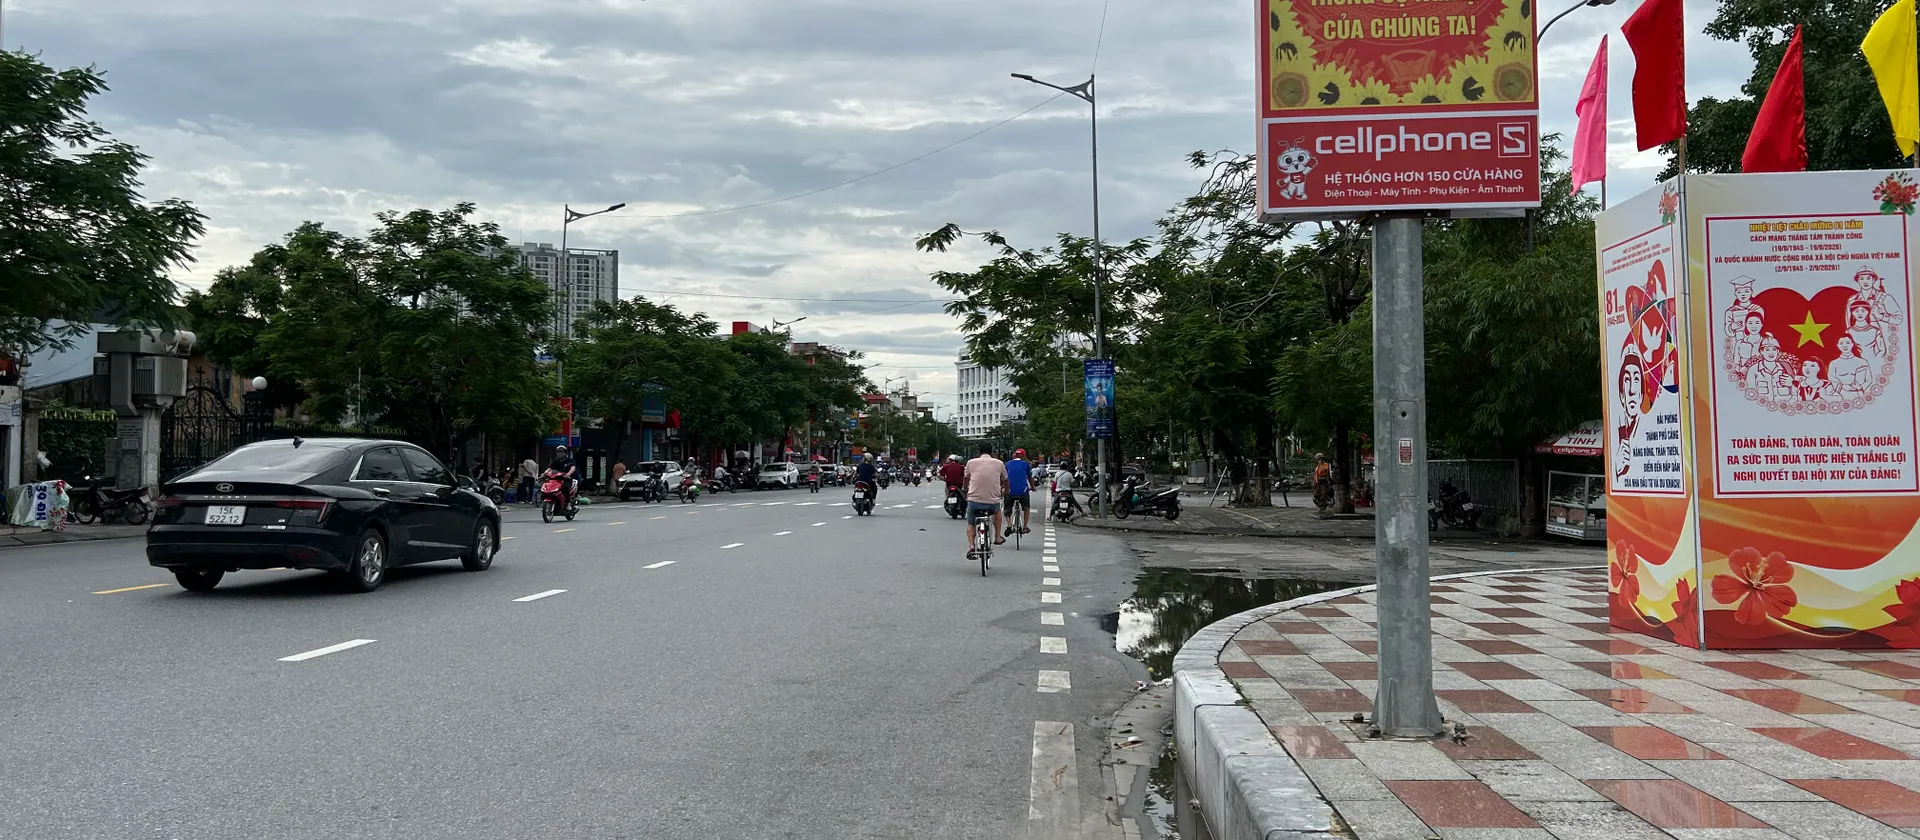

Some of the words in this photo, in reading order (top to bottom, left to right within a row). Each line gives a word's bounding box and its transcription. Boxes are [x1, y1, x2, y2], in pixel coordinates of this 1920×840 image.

[1324, 13, 1364, 40] CỦA
[1370, 13, 1440, 38] CHÚNG
[1447, 15, 1476, 36] TA!
[1325, 172, 1342, 186] HỆ
[1345, 169, 1391, 183] THỐNG
[1394, 171, 1424, 182] HƠN
[1427, 170, 1450, 181] 150
[1453, 168, 1482, 180] CỬA
[1484, 168, 1523, 180] HÀNG
[1324, 189, 1345, 198] Điện
[1347, 188, 1372, 197] Thoại
[1380, 188, 1399, 197] Máy
[1401, 186, 1421, 195] Tính
[1429, 186, 1447, 196] Phụ
[1449, 186, 1469, 196] Kiện
[1478, 184, 1494, 194] Âm
[1495, 185, 1524, 193] Thanh
[1749, 222, 1771, 233] NHIỆT
[1772, 222, 1788, 232] LIỆT
[1789, 221, 1809, 231] CHÀO
[1810, 220, 1833, 230] MỪNG
[1845, 219, 1863, 229] NĂM
[1724, 254, 1740, 263] QUỐC
[1825, 253, 1835, 262] HỘI
[1871, 252, 1884, 260] VIỆT
[1606, 288, 1617, 315] 81
[1731, 437, 1756, 448] TOÀN
[1759, 435, 1789, 448] ĐẢNG,
[1791, 436, 1817, 447] TOÀN
[1820, 435, 1842, 448] DÂN,
[1845, 435, 1870, 446] TOÀN
[1874, 434, 1900, 447] QUÂN
[1727, 456, 1739, 465] RA
[1742, 453, 1761, 464] SỨC
[1764, 454, 1779, 464] THI
[1782, 454, 1801, 464] ĐUA
[1804, 453, 1828, 466] THỰC
[1831, 452, 1854, 465] HIỆN
[1856, 450, 1888, 463] THẮNG
[1891, 452, 1906, 464] LỢI
[1734, 472, 1756, 483] NGHỊ
[1760, 468, 1789, 482] QUYẾT
[1792, 471, 1808, 482] ĐẠI
[1811, 468, 1827, 482] HỘI
[1830, 470, 1845, 480] XIV
[1848, 467, 1868, 479] CỦA
[1870, 466, 1901, 479] ĐẢNG!
[209, 515, 239, 523] 522.12
